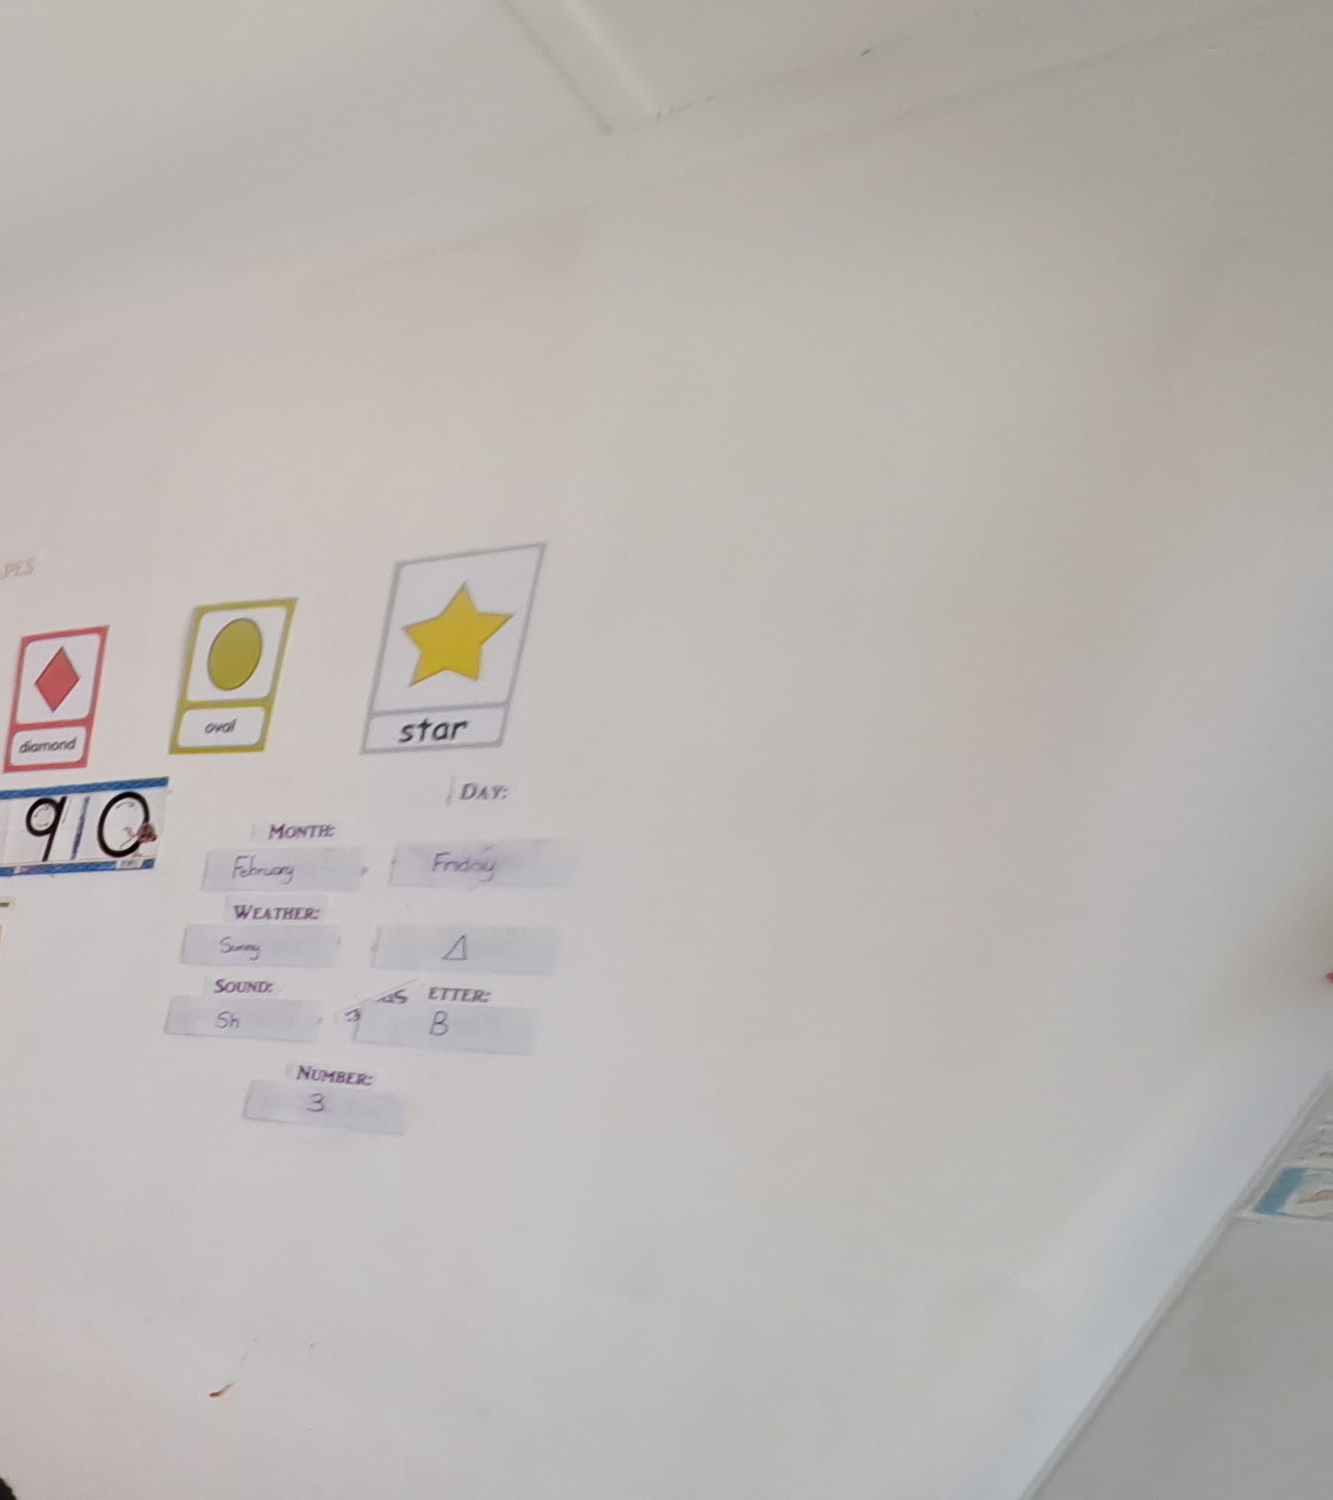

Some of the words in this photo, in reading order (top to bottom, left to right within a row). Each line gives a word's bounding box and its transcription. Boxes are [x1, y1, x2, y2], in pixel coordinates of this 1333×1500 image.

[204, 718, 238, 734] oval
[398, 717, 469, 744] star
[19, 736, 78, 754] diamond
[25, 796, 68, 862] 9
[431, 852, 498, 882] Friday
[428, 986, 492, 1004] ETTER:
[429, 1011, 450, 1036] B
[306, 1093, 327, 1114] 3
